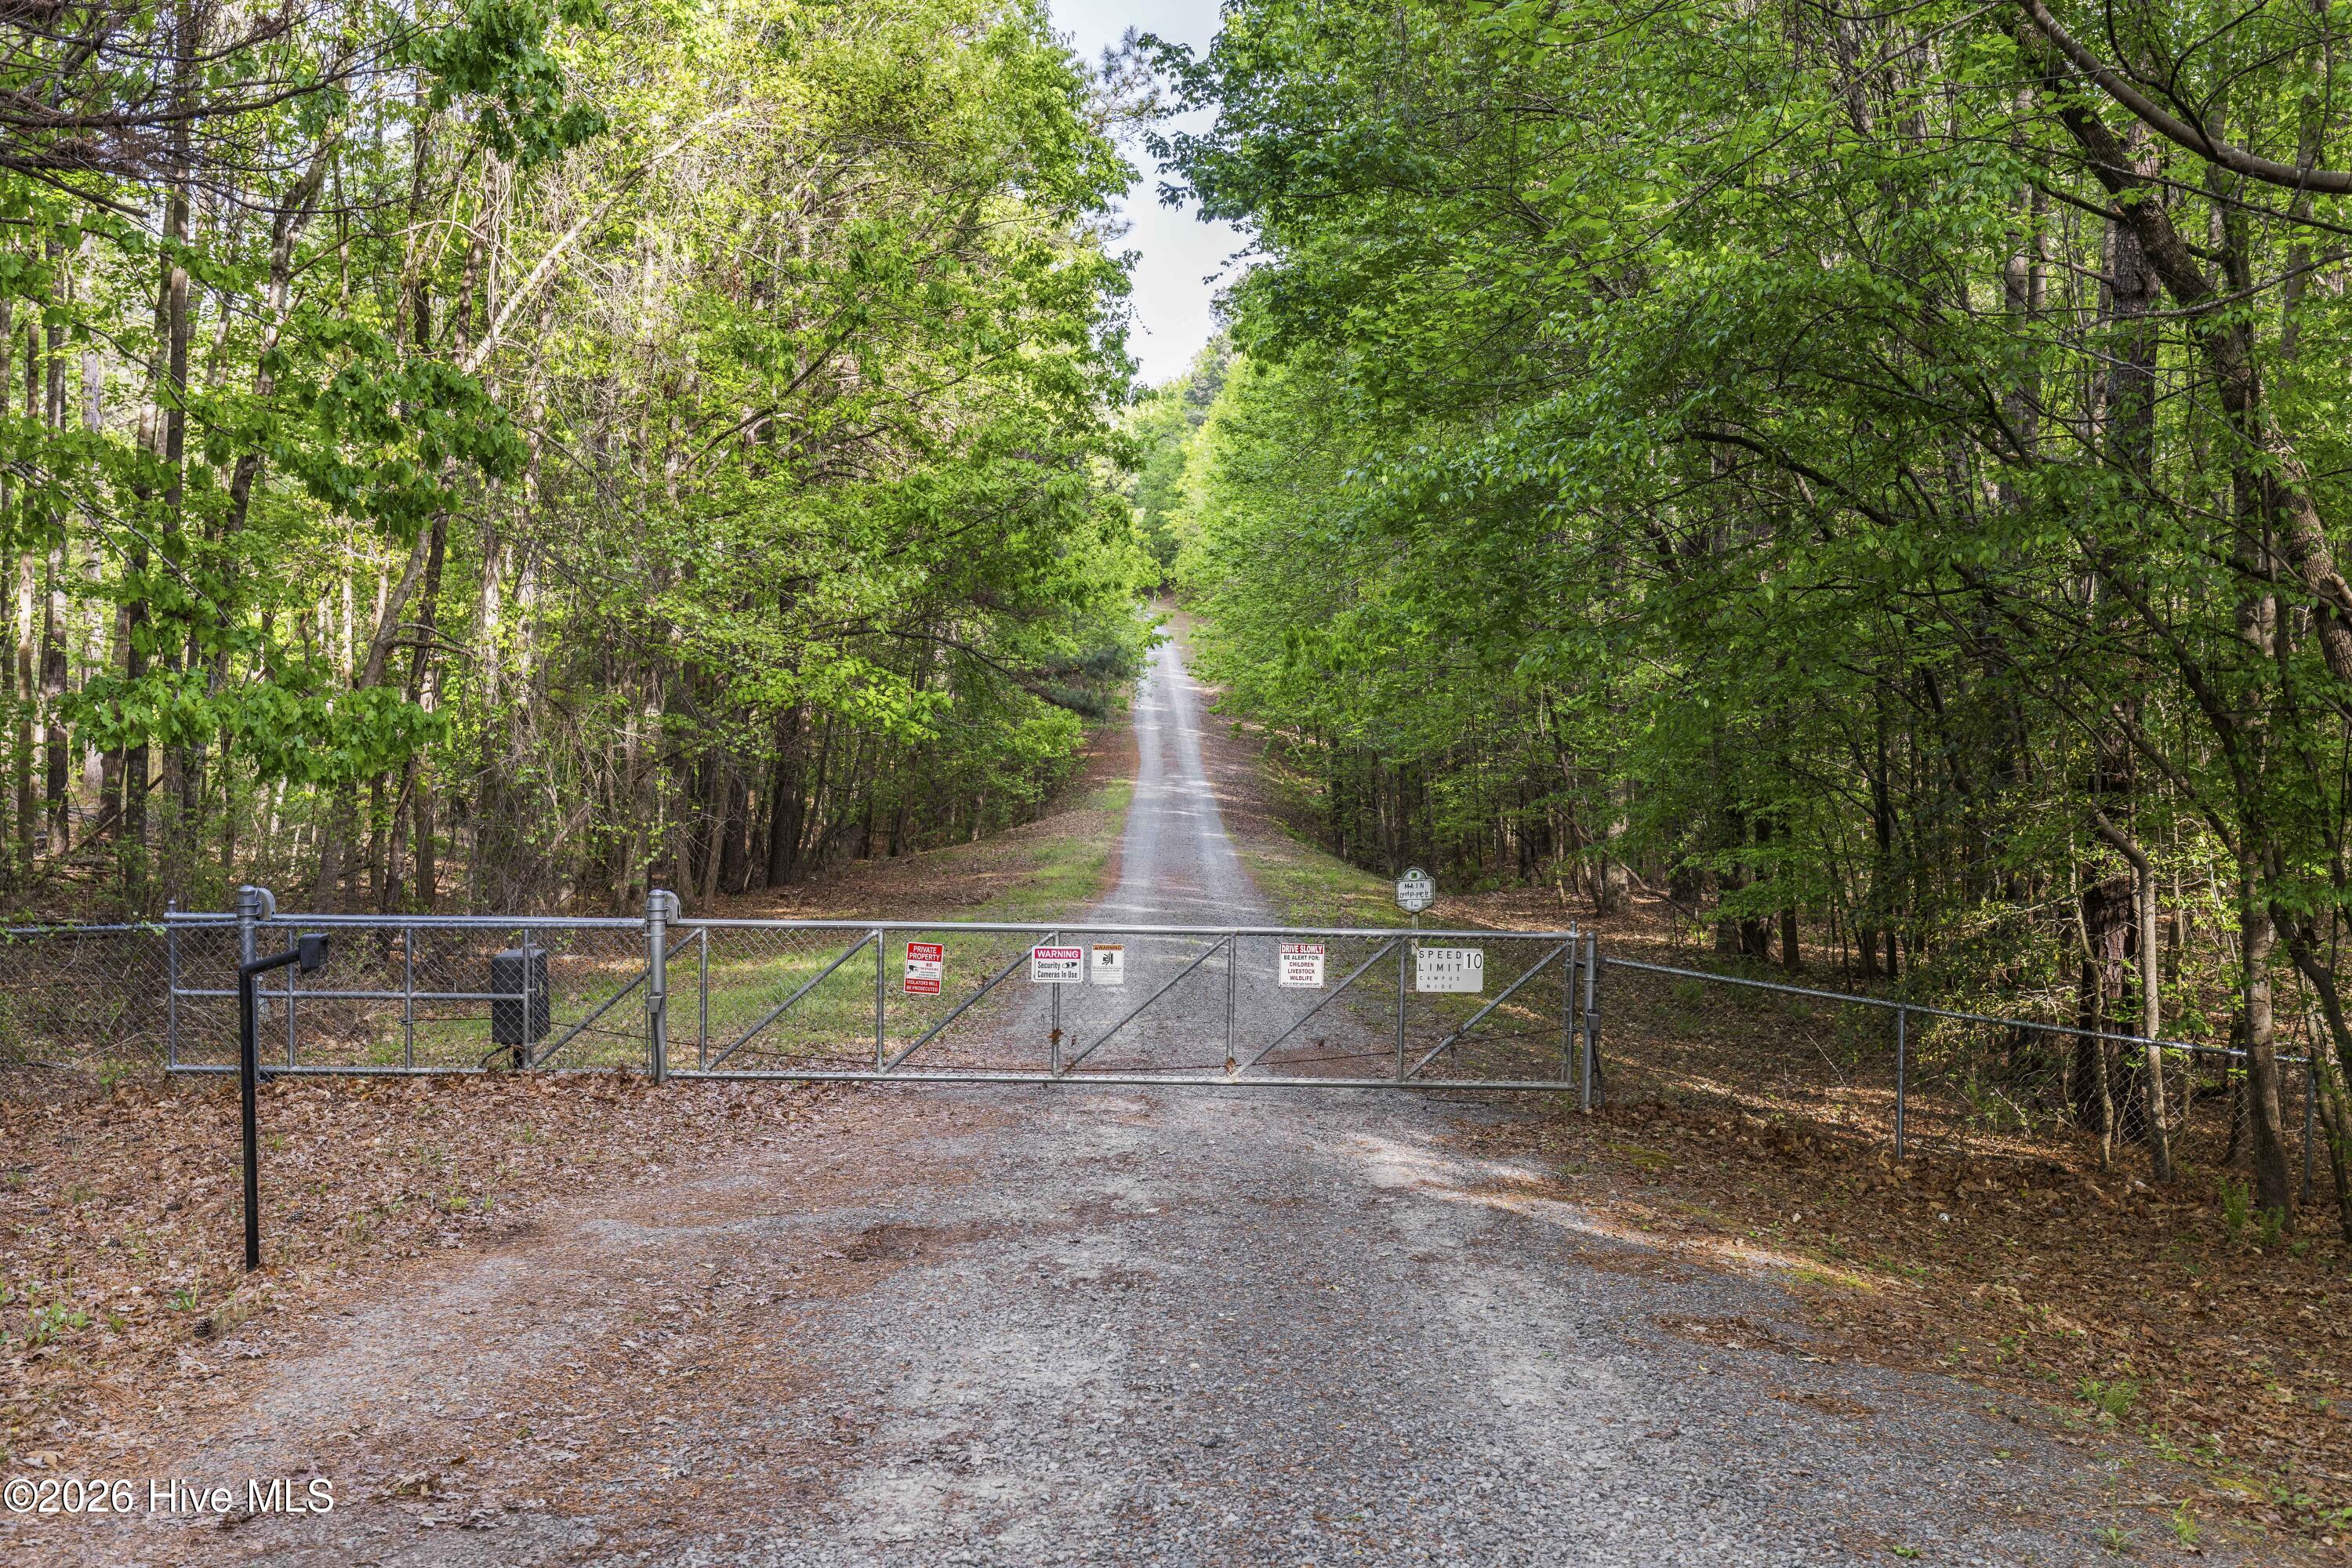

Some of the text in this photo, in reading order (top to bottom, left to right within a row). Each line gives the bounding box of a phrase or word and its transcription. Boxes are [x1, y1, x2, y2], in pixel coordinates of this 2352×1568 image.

[1037, 949, 1079, 958] WARNING
[1282, 945, 1322, 953] DRIVE SLOWLY
[1419, 950, 1462, 959] SPEED
[1037, 961, 1061, 970] Security
[1466, 953, 1483, 969] 10
